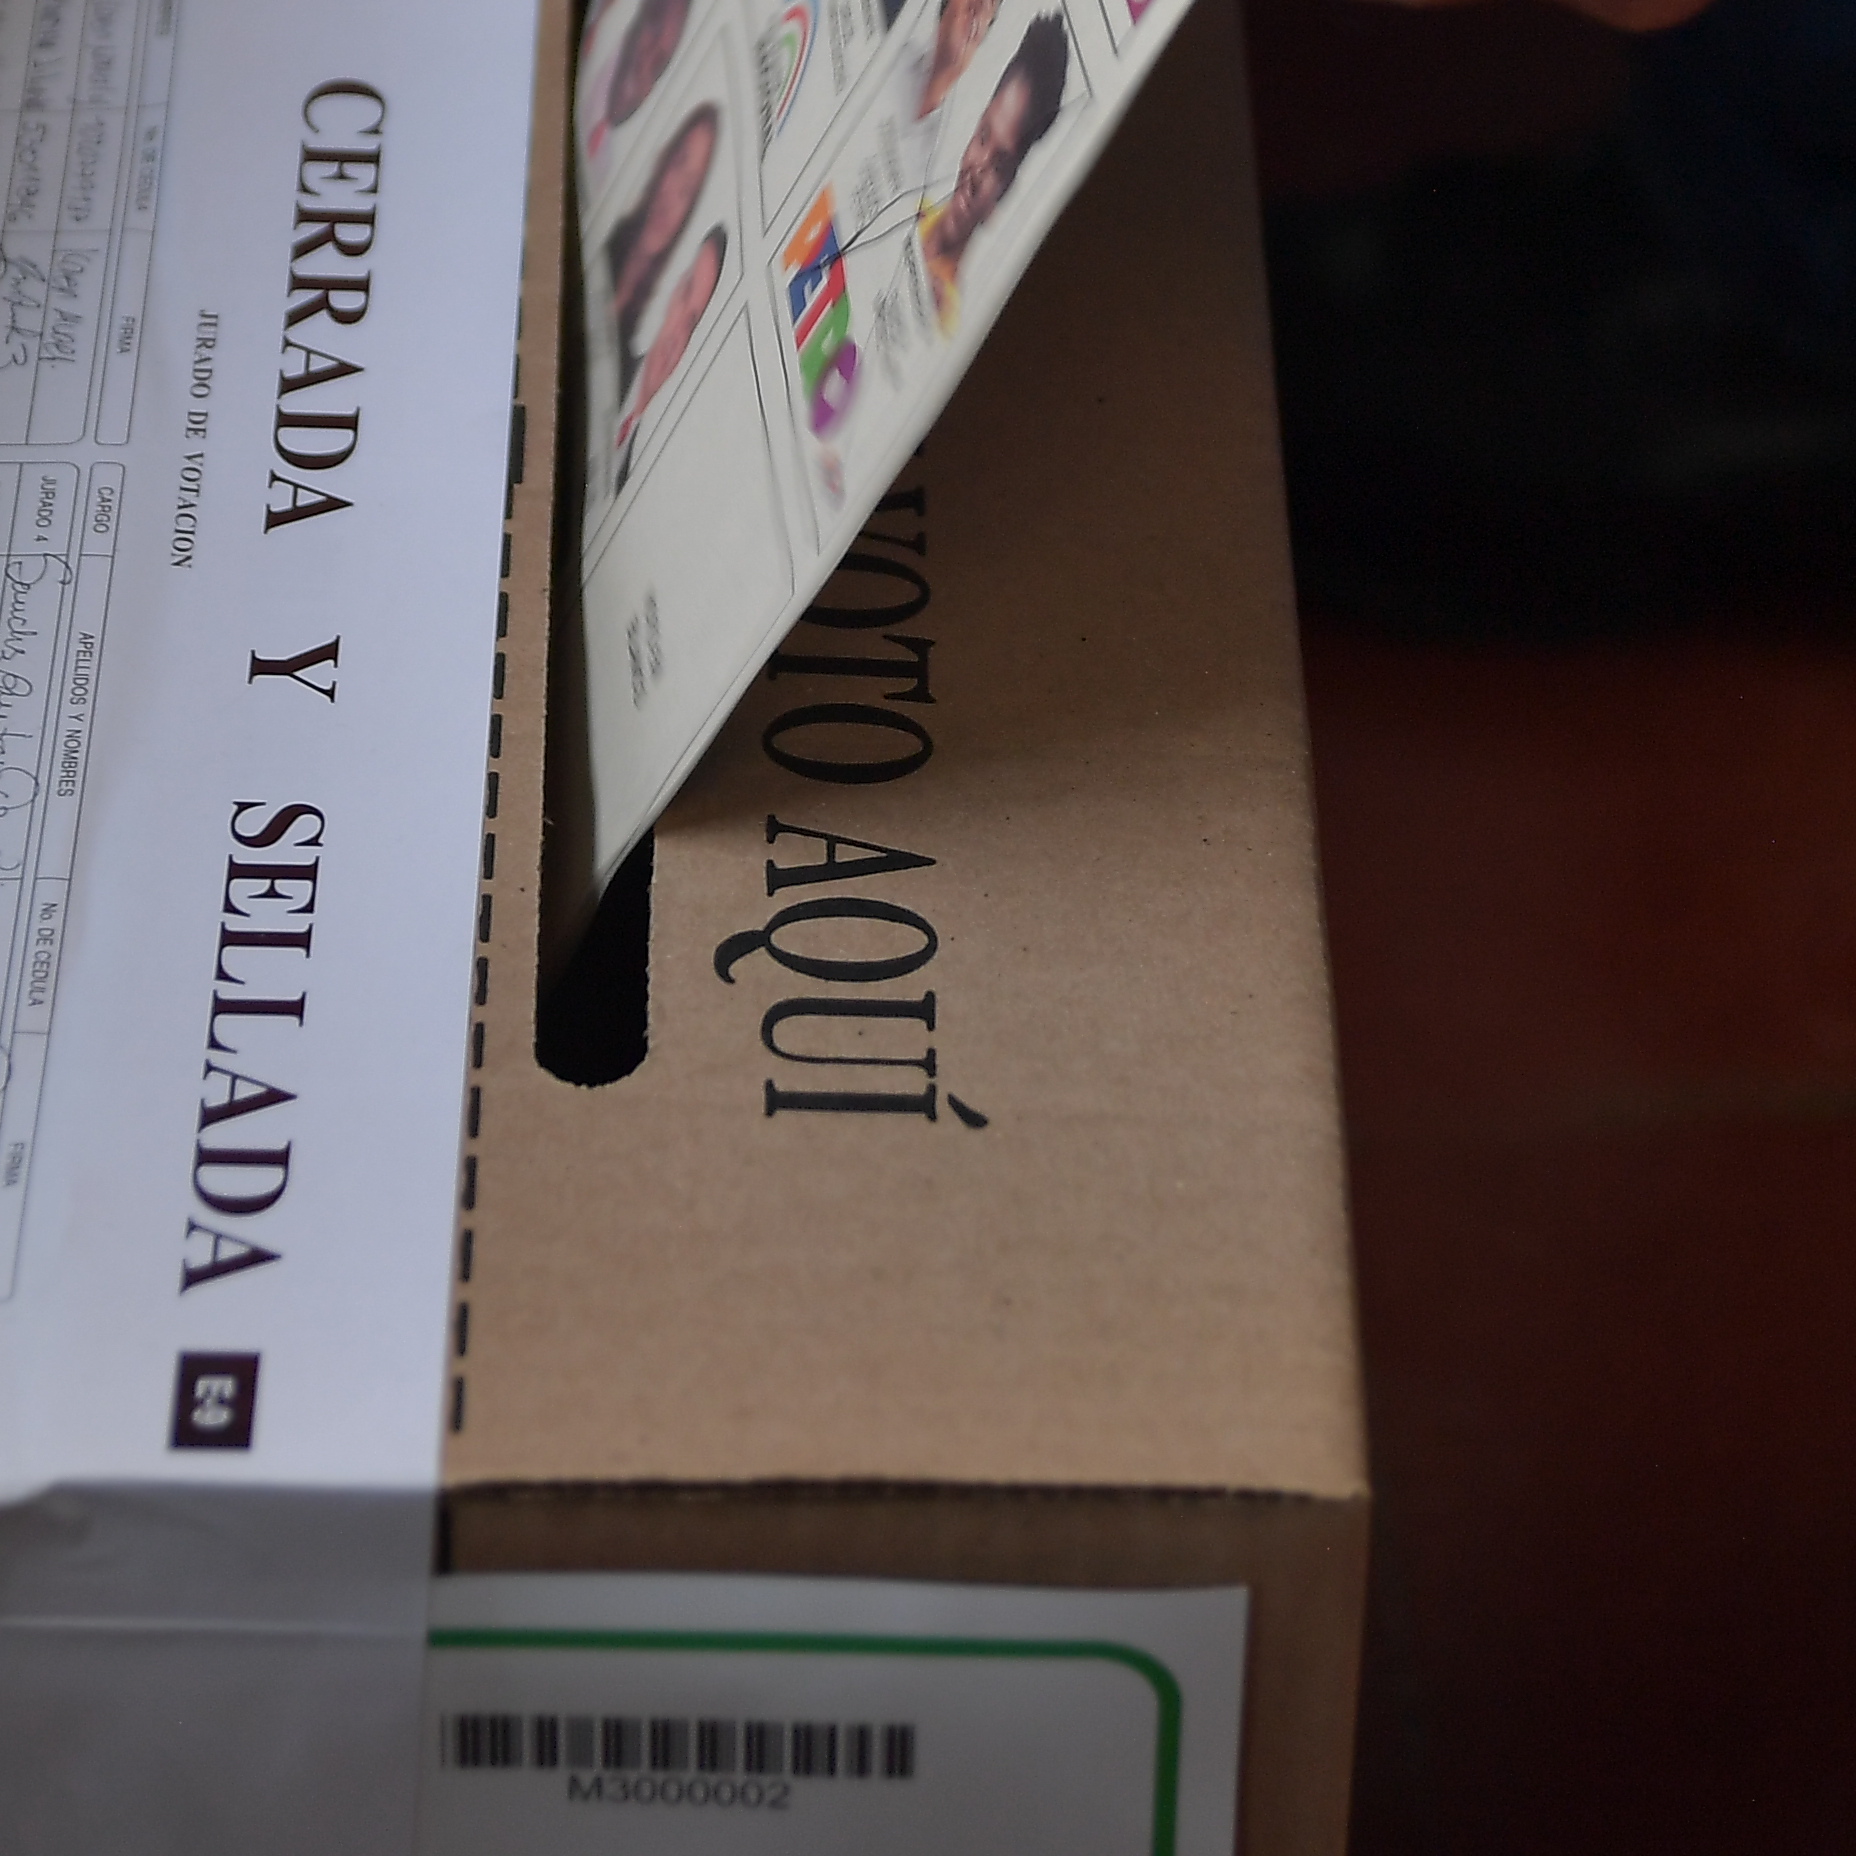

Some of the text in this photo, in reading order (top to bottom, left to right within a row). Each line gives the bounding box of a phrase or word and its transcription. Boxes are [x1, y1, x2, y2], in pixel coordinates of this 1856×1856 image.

[256, 77, 394, 534] CERRADA
[168, 310, 221, 569] JURADO DE VOTACION
[33, 476, 58, 542] JURADO 4
[91, 486, 114, 534] CARGO
[55, 631, 95, 797] APELLIDOS Y NOMBRES
[242, 635, 342, 702] Y
[27, 901, 57, 1007] No. DE CEDULA
[713, 814, 989, 1129] AQUÍ
[178, 800, 328, 1294] SELLADA
[1, 1142, 25, 1187] FIRMA
[567, 1774, 792, 1810] M3000002
